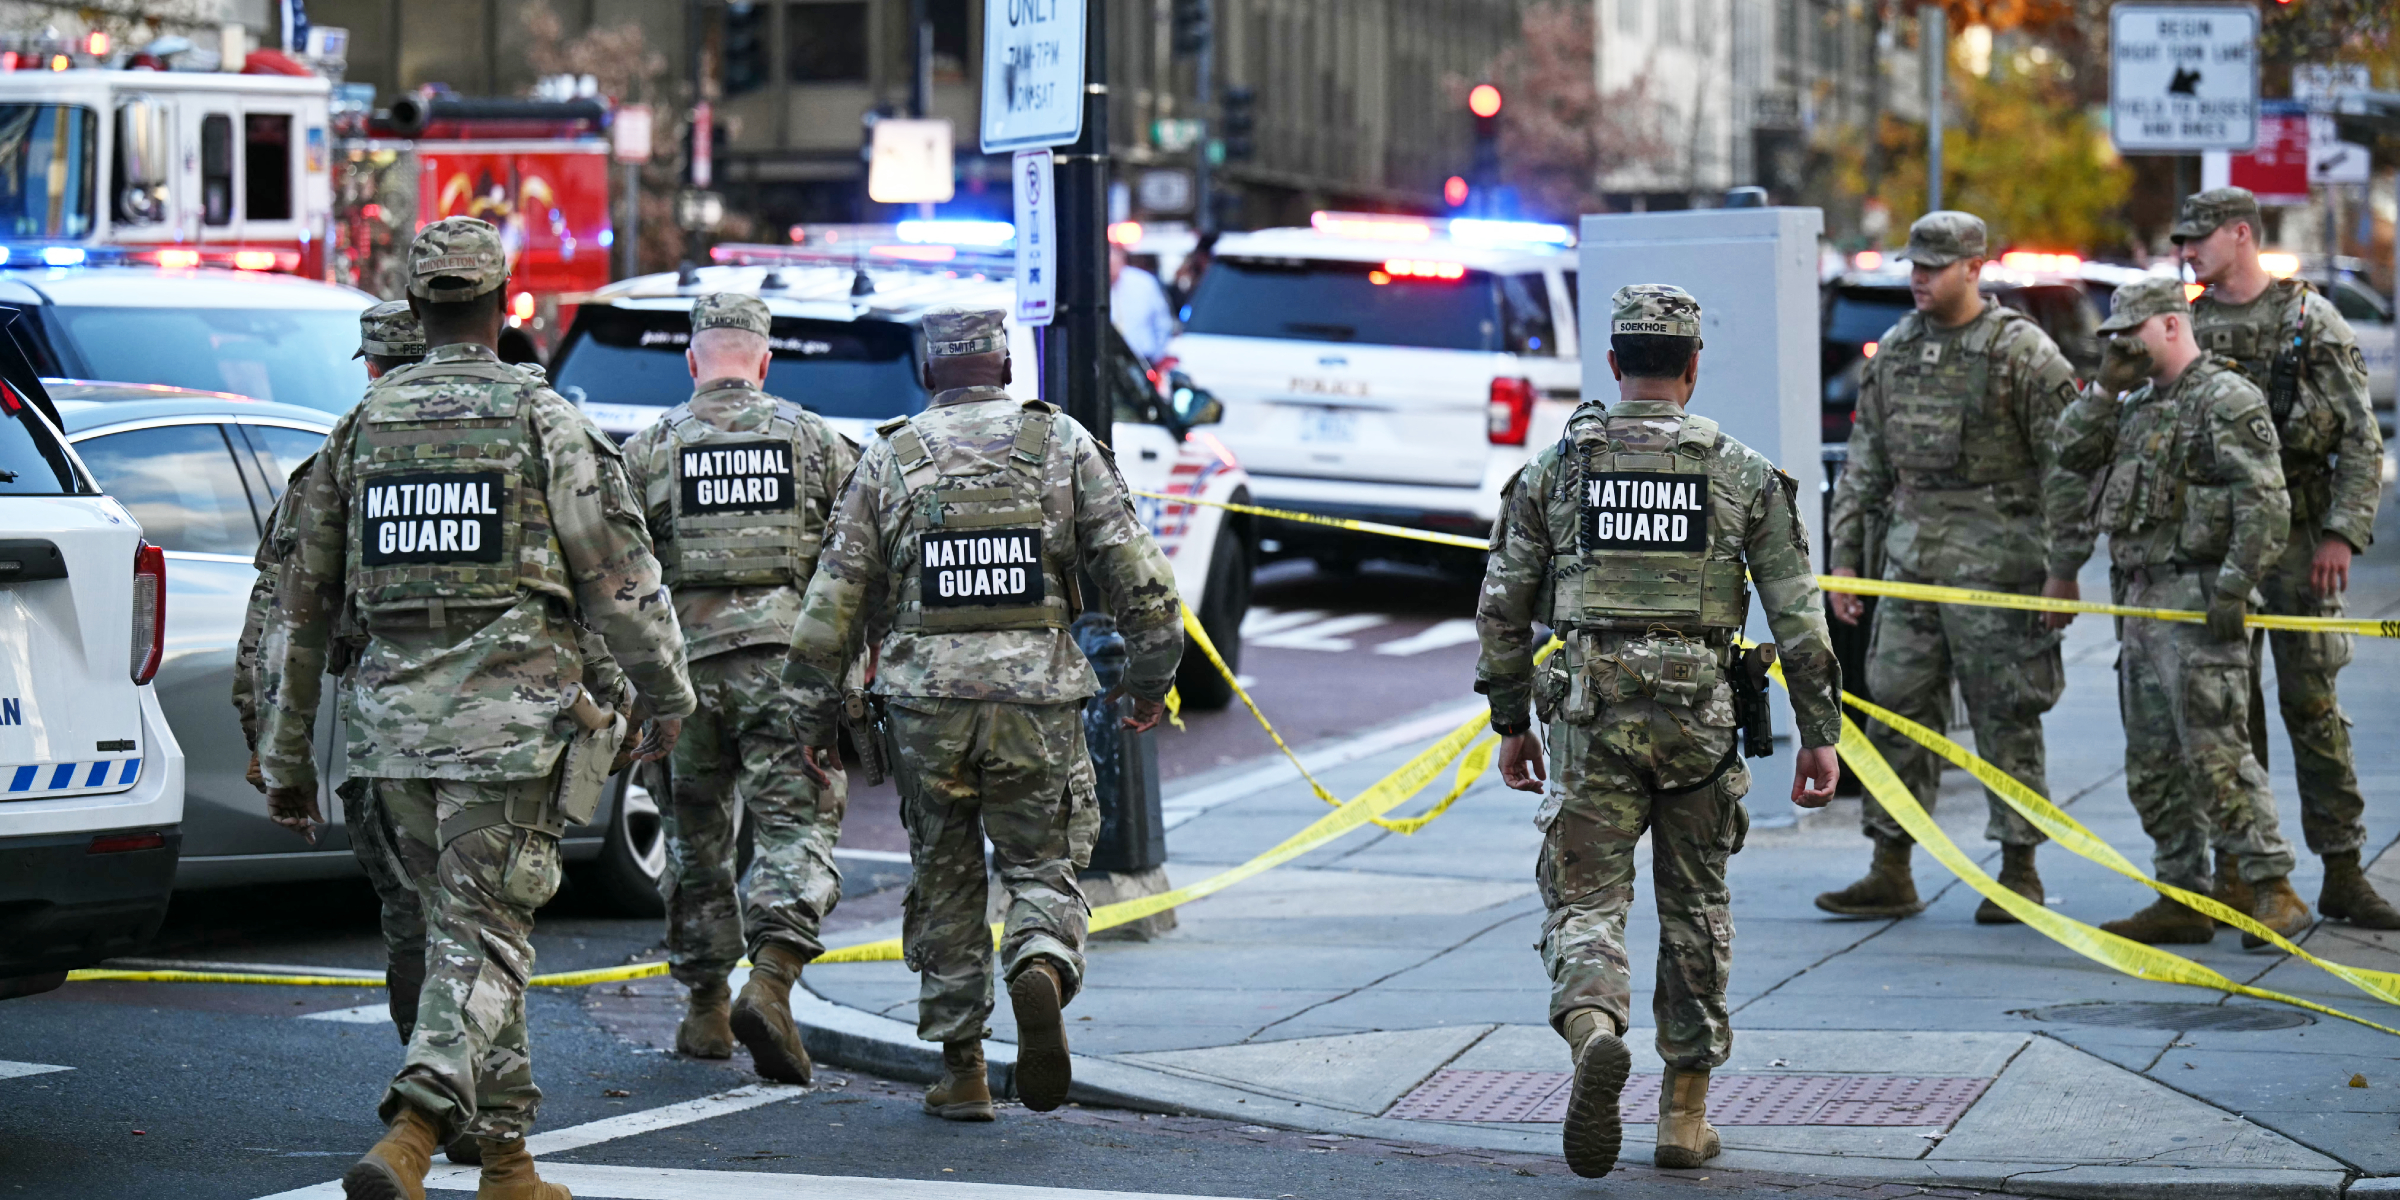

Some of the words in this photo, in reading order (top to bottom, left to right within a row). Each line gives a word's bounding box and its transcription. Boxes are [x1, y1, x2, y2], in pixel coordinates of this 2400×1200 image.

[1008, 0, 1058, 27] ONLY
[2158, 19, 2212, 37] BEGIN
[418, 256, 477, 272] MIDDLETON
[705, 316, 750, 328] BLANCHARD
[1620, 322, 1668, 332] SOEKHOE
[949, 342, 976, 353] SMITH
[1289, 378, 1369, 397] POLICE
[684, 449, 790, 478] NATIONAL
[368, 482, 497, 519] NATIONAL
[697, 477, 779, 505] GUARD
[1587, 480, 1702, 511] NATIONAL
[379, 519, 481, 554] GUARD
[1598, 511, 1688, 542] GUARD
[925, 536, 1037, 568] NATIONAL
[939, 567, 1026, 598] GUARD
[0, 697, 21, 726] N
